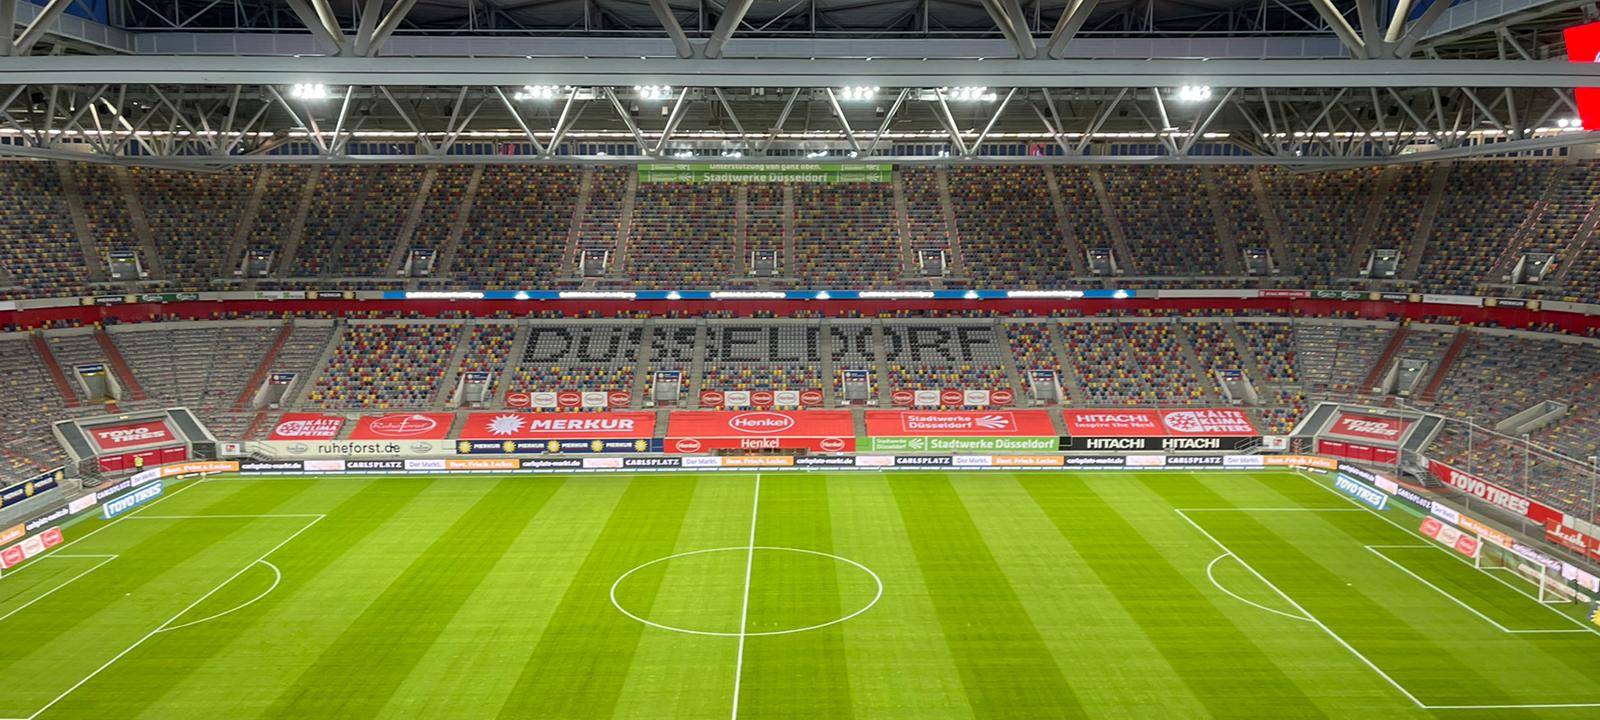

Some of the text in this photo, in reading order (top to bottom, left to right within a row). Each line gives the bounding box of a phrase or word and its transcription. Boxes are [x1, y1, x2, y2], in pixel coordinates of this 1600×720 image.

[703, 172, 828, 182] Stadtwerke Düsseldorf
[530, 419, 634, 430] MERKUR
[735, 416, 788, 427] Henkel
[1342, 418, 1389, 428] TOYO
[98, 427, 149, 439] TOYO
[1347, 424, 1399, 436] TIRES
[111, 430, 166, 443] TIRES
[318, 442, 401, 454] ruheforst.de
[741, 438, 780, 448] Henkel
[931, 438, 1054, 449] Stadtwerke Düsseldorf
[1087, 439, 1145, 449] HITACHI
[1162, 439, 1220, 449] HITACHI
[1336, 476, 1383, 507] TOYO TIRES
[1449, 470, 1487, 499] TOYO
[1486, 488, 1531, 516] TIRES
[108, 484, 163, 514] TOYO TIRES
